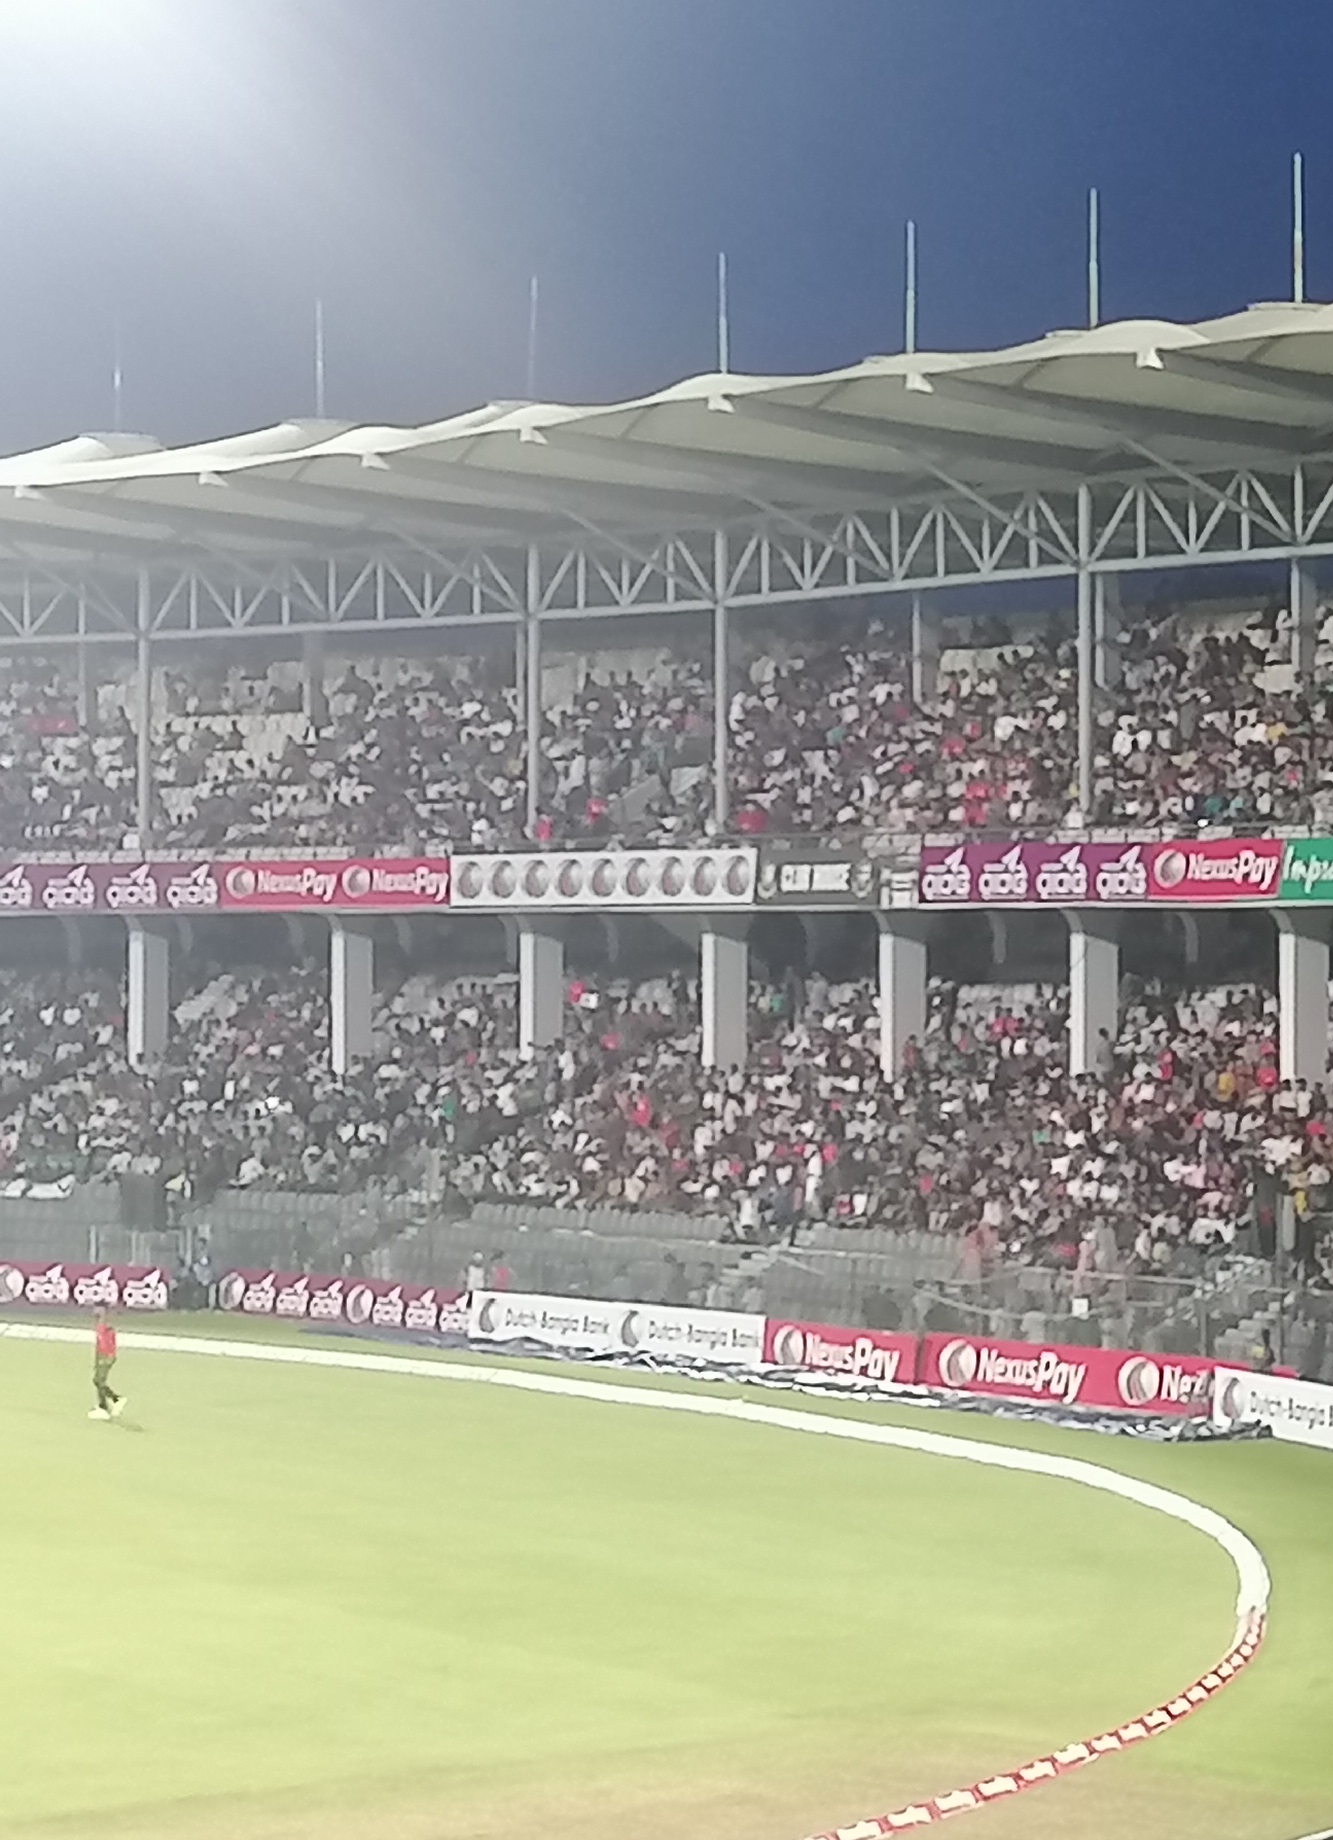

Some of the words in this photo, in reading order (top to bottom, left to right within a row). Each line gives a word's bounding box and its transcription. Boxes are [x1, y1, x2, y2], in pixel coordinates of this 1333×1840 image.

[258, 867, 337, 902] NexusPay
[372, 866, 448, 902] NexusPay
[1186, 850, 1278, 889] NexusPay
[805, 1333, 898, 1382] NexusPay
[977, 1348, 1086, 1404] NexusPay
